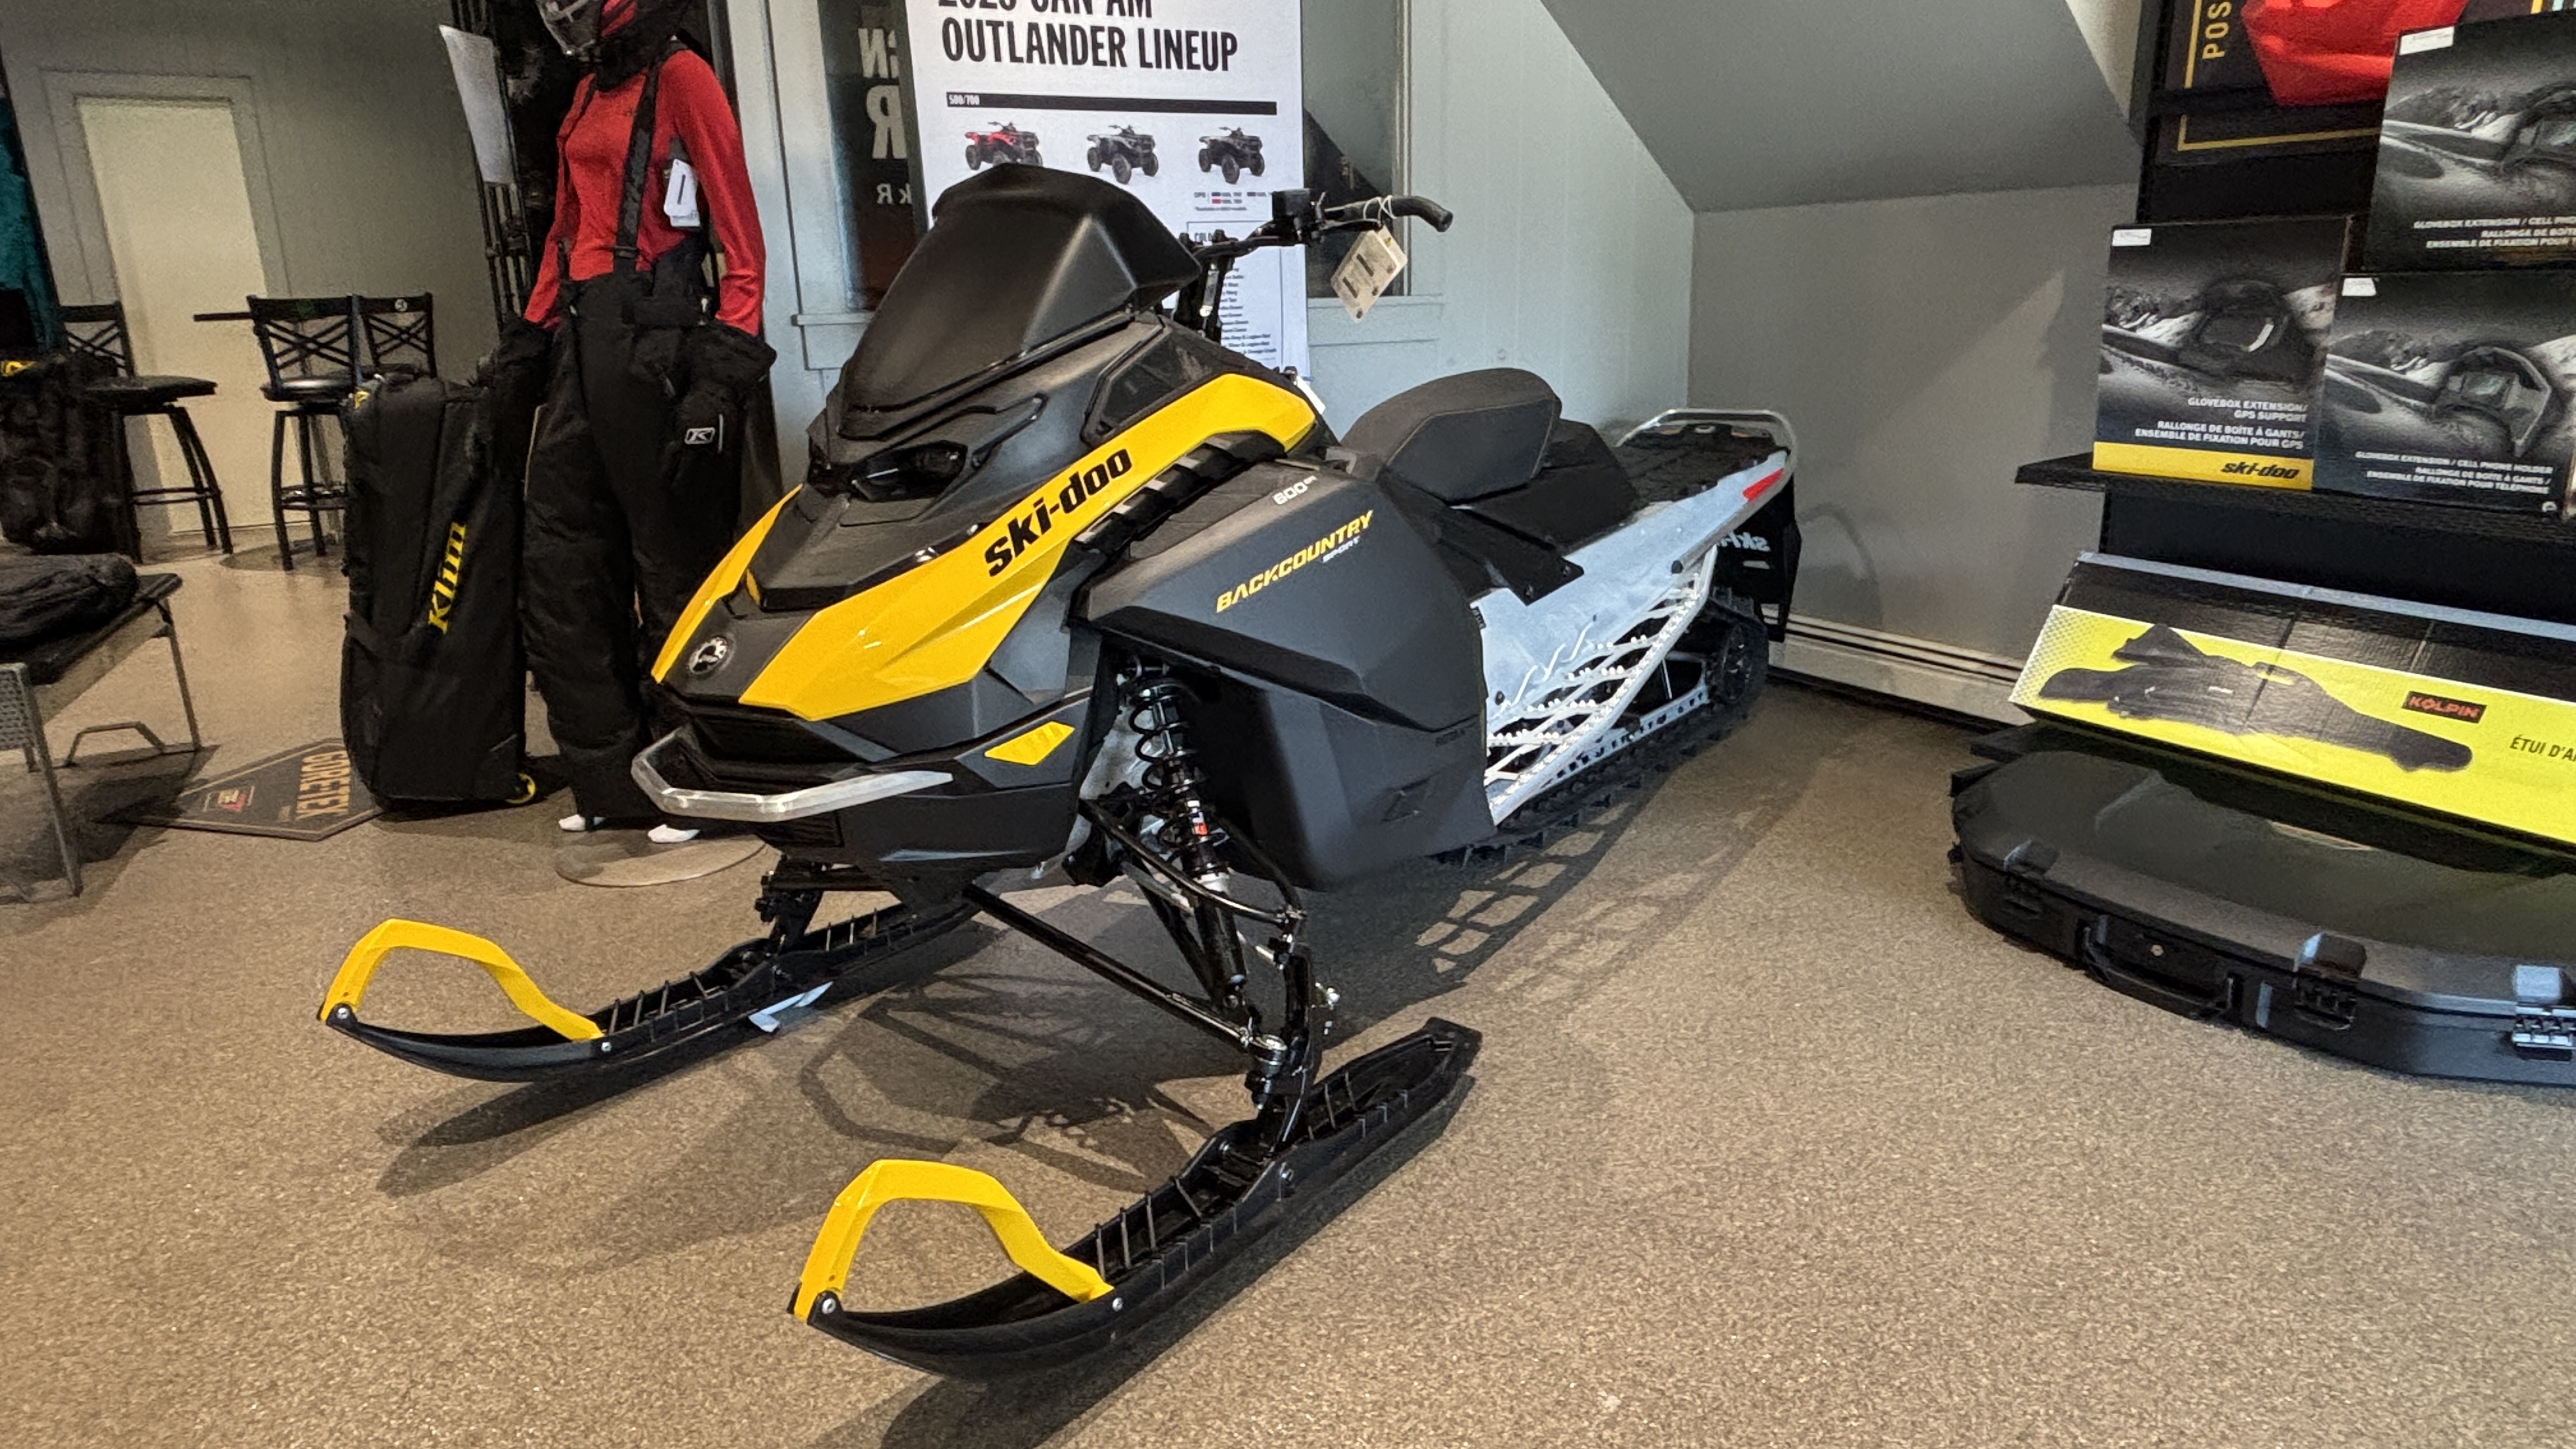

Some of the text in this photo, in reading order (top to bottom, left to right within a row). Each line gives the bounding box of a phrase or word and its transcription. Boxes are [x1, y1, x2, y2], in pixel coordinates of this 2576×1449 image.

[942, 17, 1127, 67] OUTLANDER
[1137, 27, 1238, 71] LINEUP
[2188, 397, 2241, 408] GLOVEBOX
[2234, 410, 2255, 420] GPS
[2158, 420, 2207, 432] RALLONGE
[2209, 424, 2223, 433] DE
[2135, 428, 2304, 450] ENSEMBLE DE FIXATION POUR GPS
[2220, 461, 2300, 479] ski-doo
[985, 448, 1132, 578] ski-doo
[1216, 509, 1374, 613] BACKCOUNTRY
[2509, 734, 2547, 755] ÉTUI
